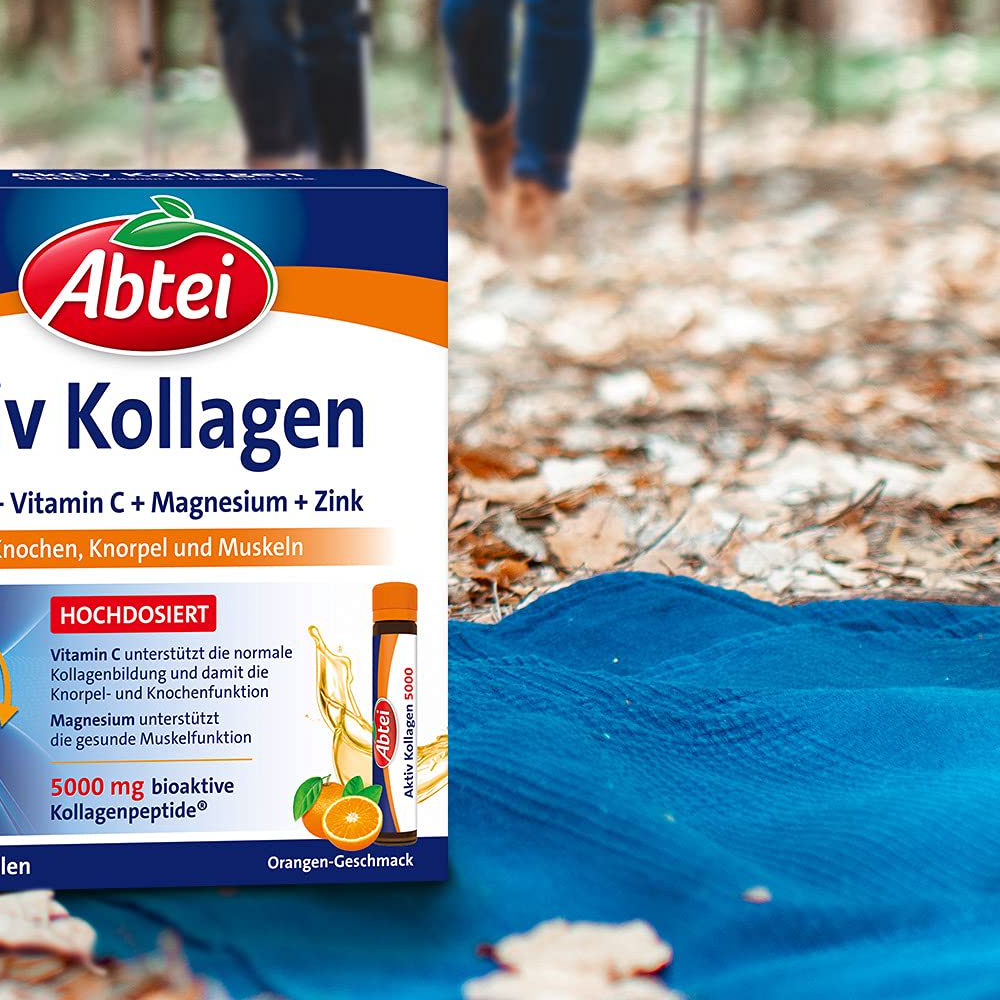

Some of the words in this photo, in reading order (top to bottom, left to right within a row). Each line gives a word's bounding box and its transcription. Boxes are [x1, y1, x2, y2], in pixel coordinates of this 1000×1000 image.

[41, 249, 235, 326] Abtei
[68, 377, 365, 473] Kollagen
[10, 491, 103, 515] Vitamin
[109, 492, 126, 514] C
[151, 490, 288, 521] Magnesium
[314, 489, 364, 512] Zink
[89, 536, 168, 564] Knorpel
[174, 536, 212, 557] und
[218, 535, 304, 557] Muskeln
[60, 604, 209, 625] HOCHDOSIERT
[51, 647, 108, 662] Vitamin
[111, 647, 121, 661] C
[124, 646, 205, 661] unterstützt
[208, 646, 231, 660] die
[234, 644, 293, 659] normale
[50, 666, 167, 685] Kollagenbildung
[170, 665, 198, 680] und
[201, 665, 244, 679] damit
[247, 664, 269, 679] die
[404, 667, 414, 700] 5000
[50, 686, 111, 704] Knorpel-
[115, 685, 143, 700] und
[147, 684, 269, 700] Knochenfunktion
[50, 712, 135, 731] Magnesium
[139, 711, 220, 726] unterstützt
[403, 704, 416, 757] Kollagen
[50, 732, 72, 747] die
[76, 731, 136, 751] gesunde
[140, 730, 252, 746] Muskelfunktion
[375, 709, 392, 763] Abtei
[51, 778, 104, 797] 5000
[110, 780, 144, 801] mg
[151, 777, 235, 796] bioaktive
[403, 763, 414, 798] Aktiv
[267, 853, 414, 873] Orangen-Geschmack
